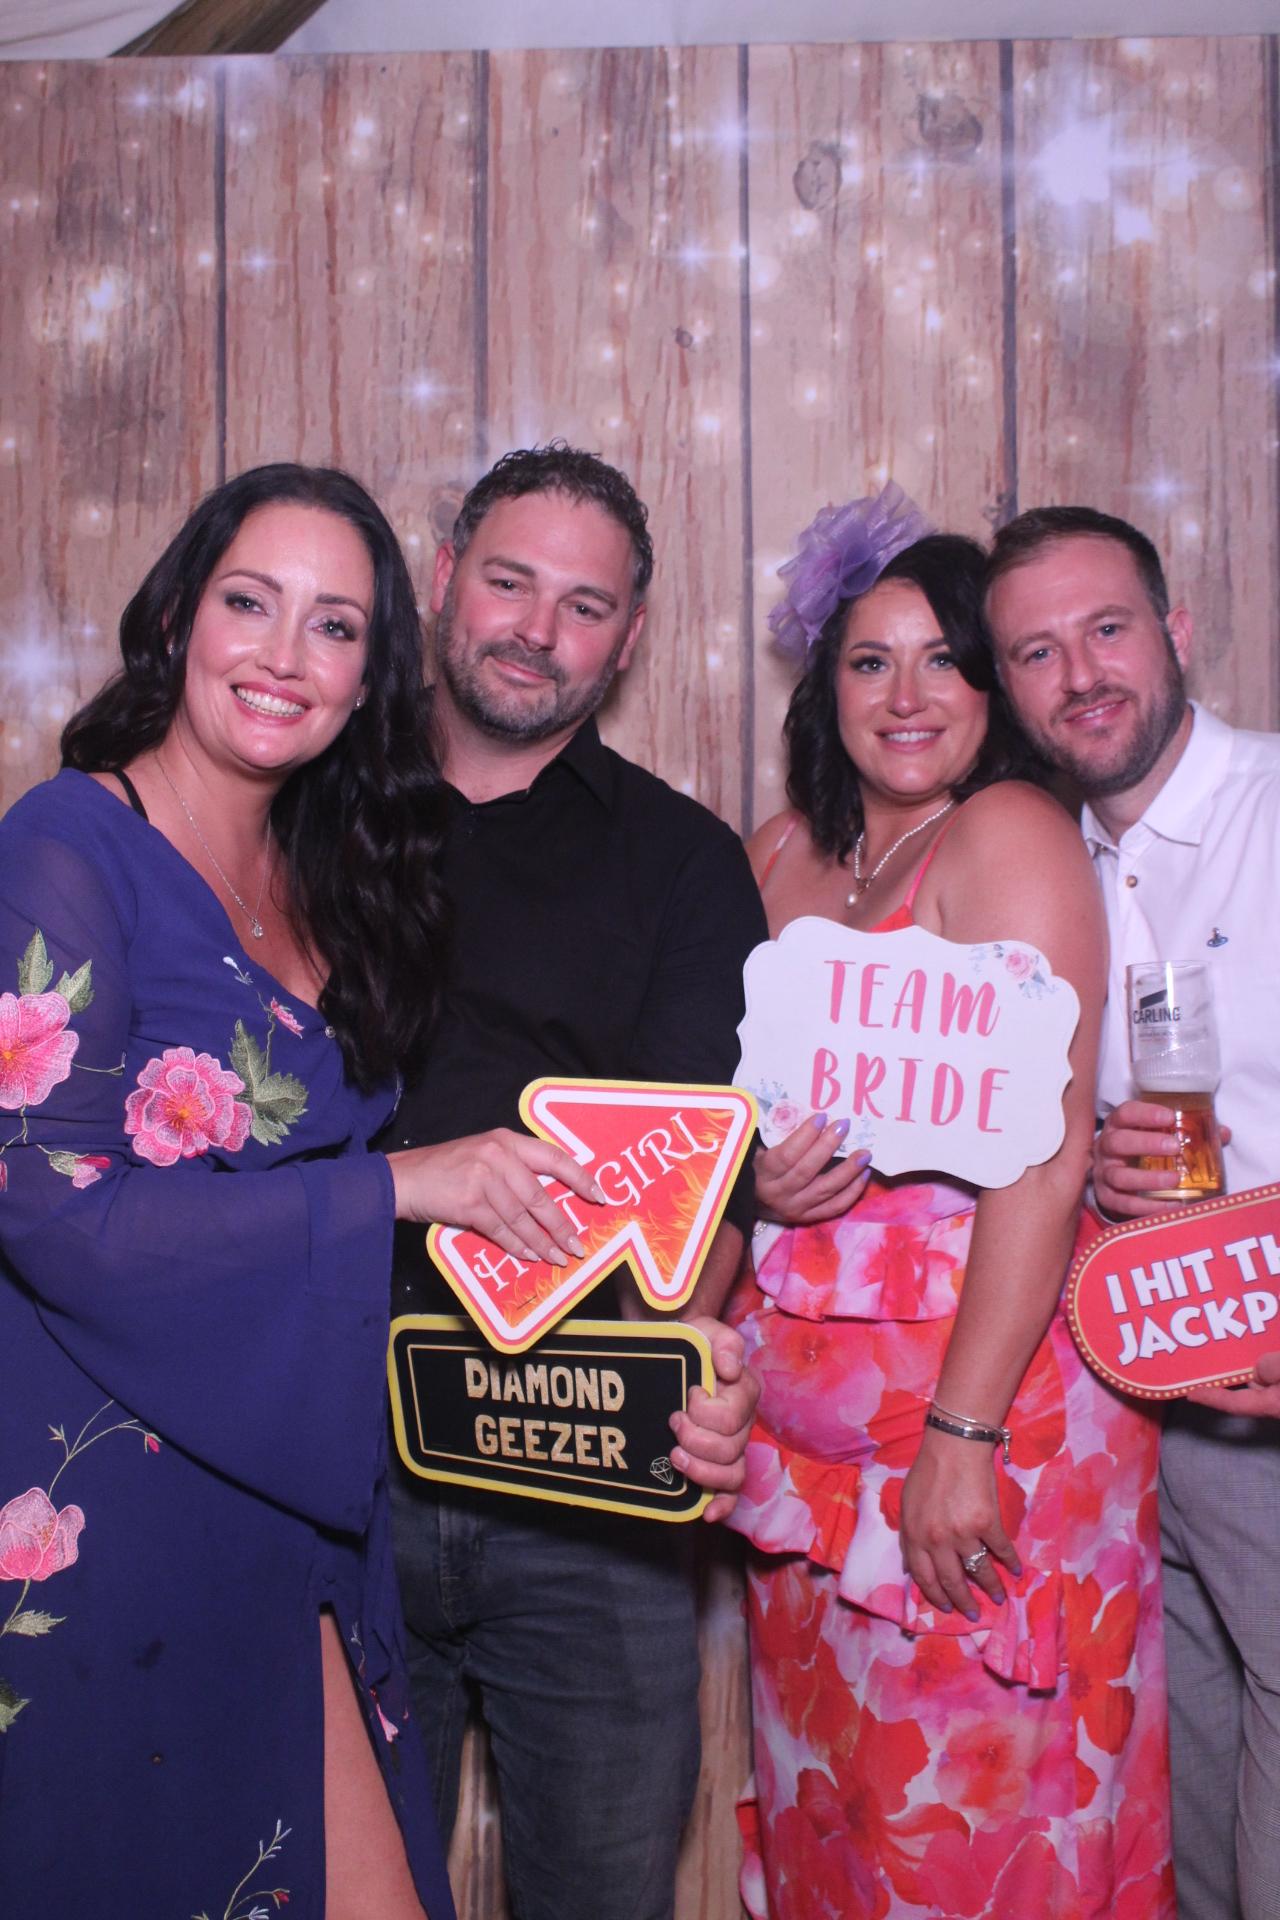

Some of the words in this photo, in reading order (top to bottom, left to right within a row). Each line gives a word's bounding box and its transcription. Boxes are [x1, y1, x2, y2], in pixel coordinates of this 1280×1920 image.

[824, 960, 1000, 1037] TEAM
[1133, 1007, 1181, 1024] CARLING
[810, 1048, 1009, 1133] BRIDE
[473, 1190, 588, 1292] HT
[594, 1111, 718, 1206] GIRL
[1106, 1274, 1128, 1314] I
[1130, 1248, 1214, 1307] HIT
[1118, 1291, 1280, 1366] JACKP
[464, 1357, 625, 1412] DIAMOND
[474, 1414, 628, 1470] GEEZER
